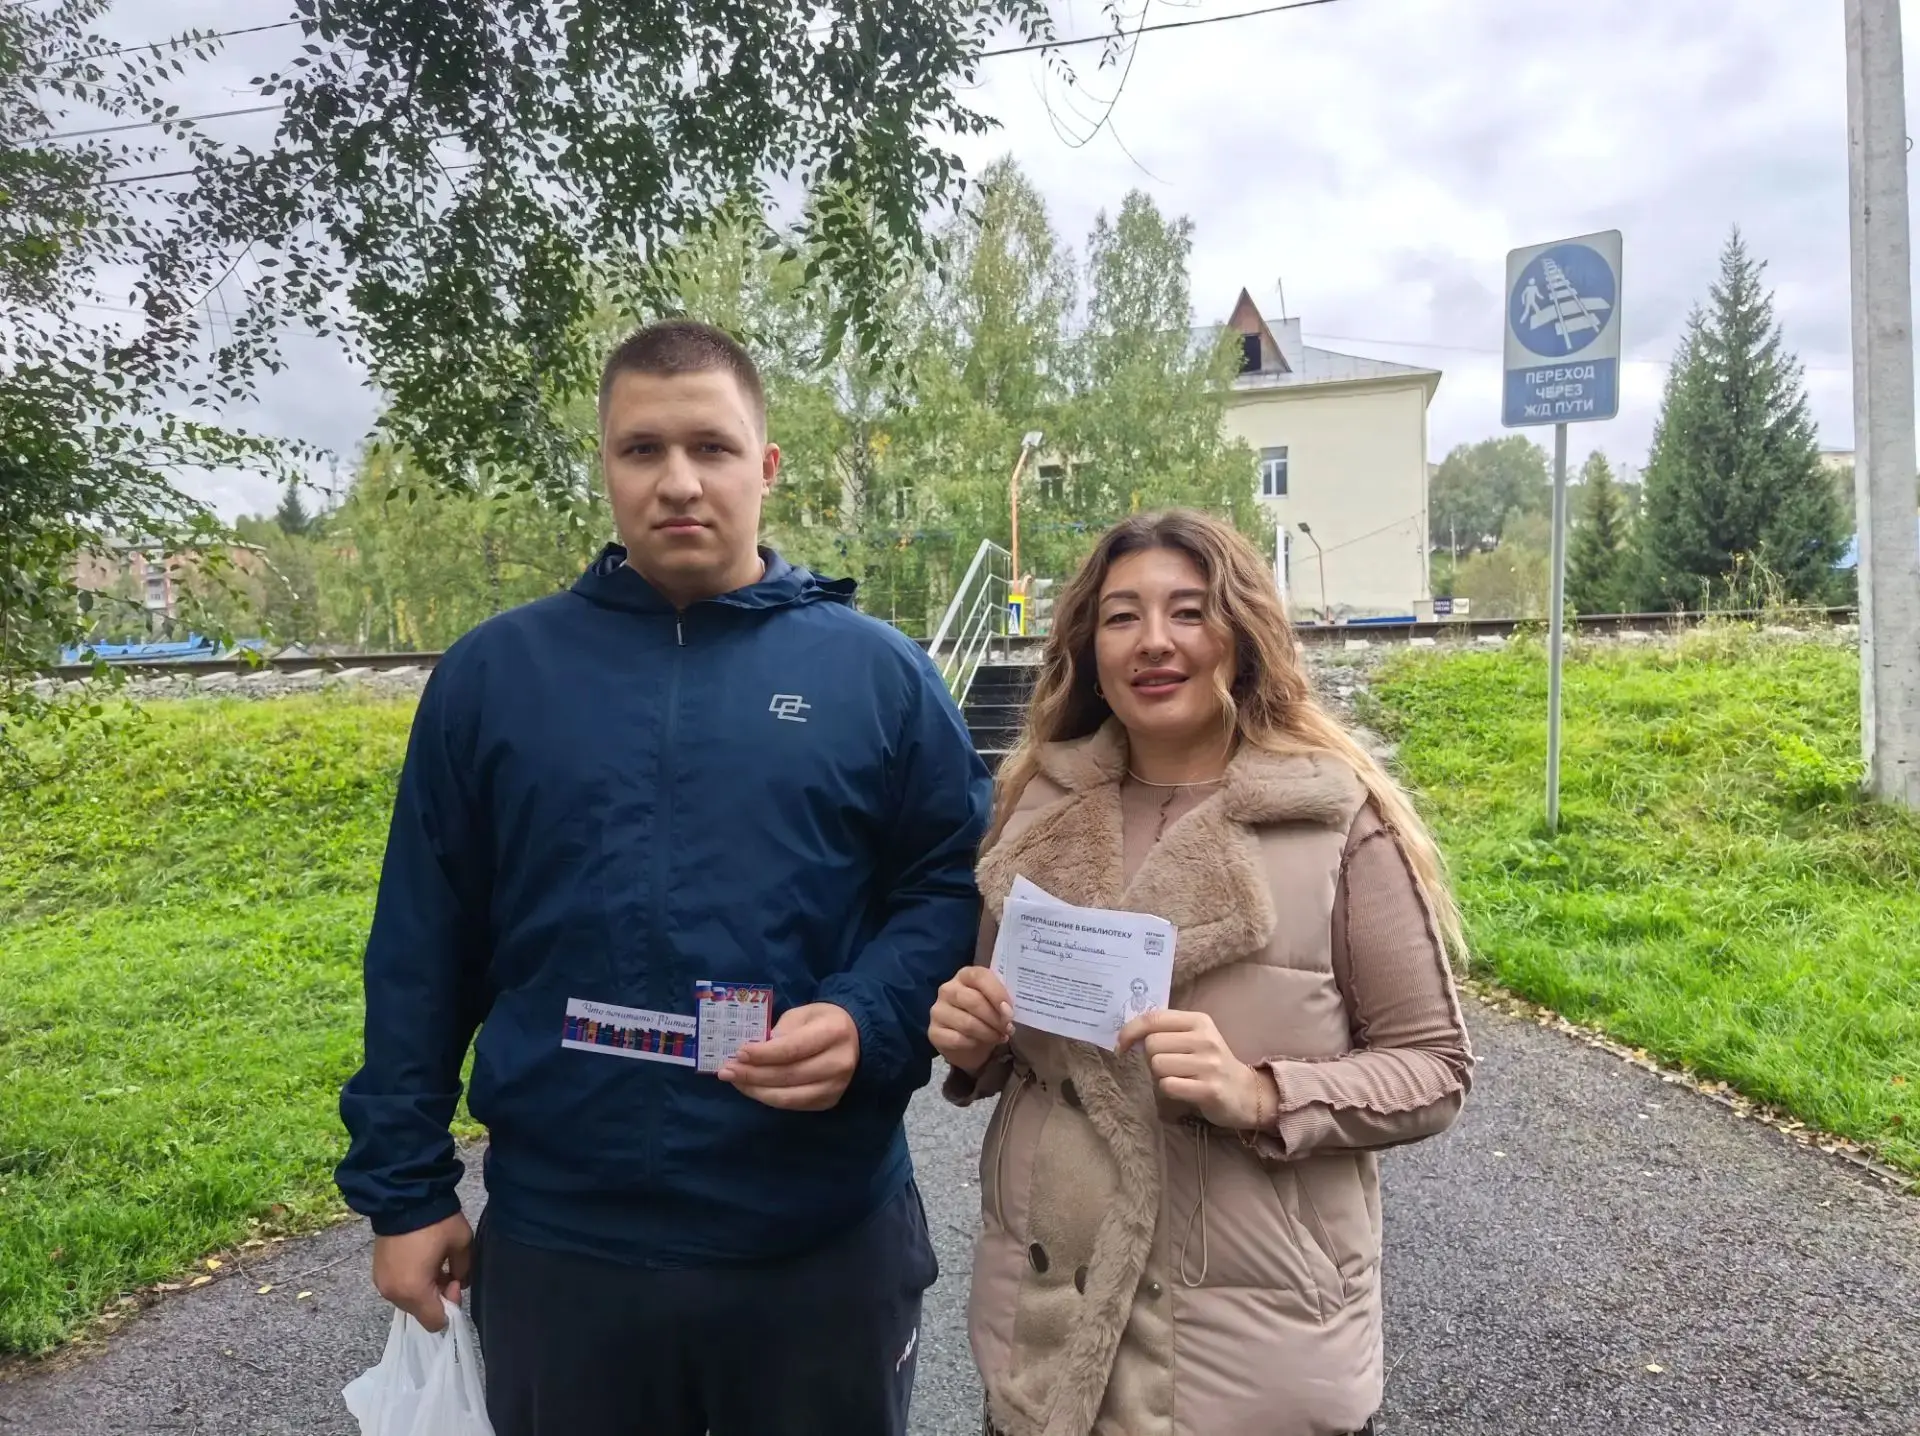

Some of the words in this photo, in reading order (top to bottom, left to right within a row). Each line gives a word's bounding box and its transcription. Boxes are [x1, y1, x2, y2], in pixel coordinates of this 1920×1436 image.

[1525, 365, 1595, 385] ПЕРЕХОД
[1535, 383, 1584, 399] ЧЕРЕЗ
[1524, 403, 1552, 417] Ж/Д
[1555, 399, 1594, 415] ПУТИ
[1020, 914, 1075, 930] ПРИГЛАШЕНИЕ
[1081, 924, 1133, 940] БИБЛИОТЕКУ
